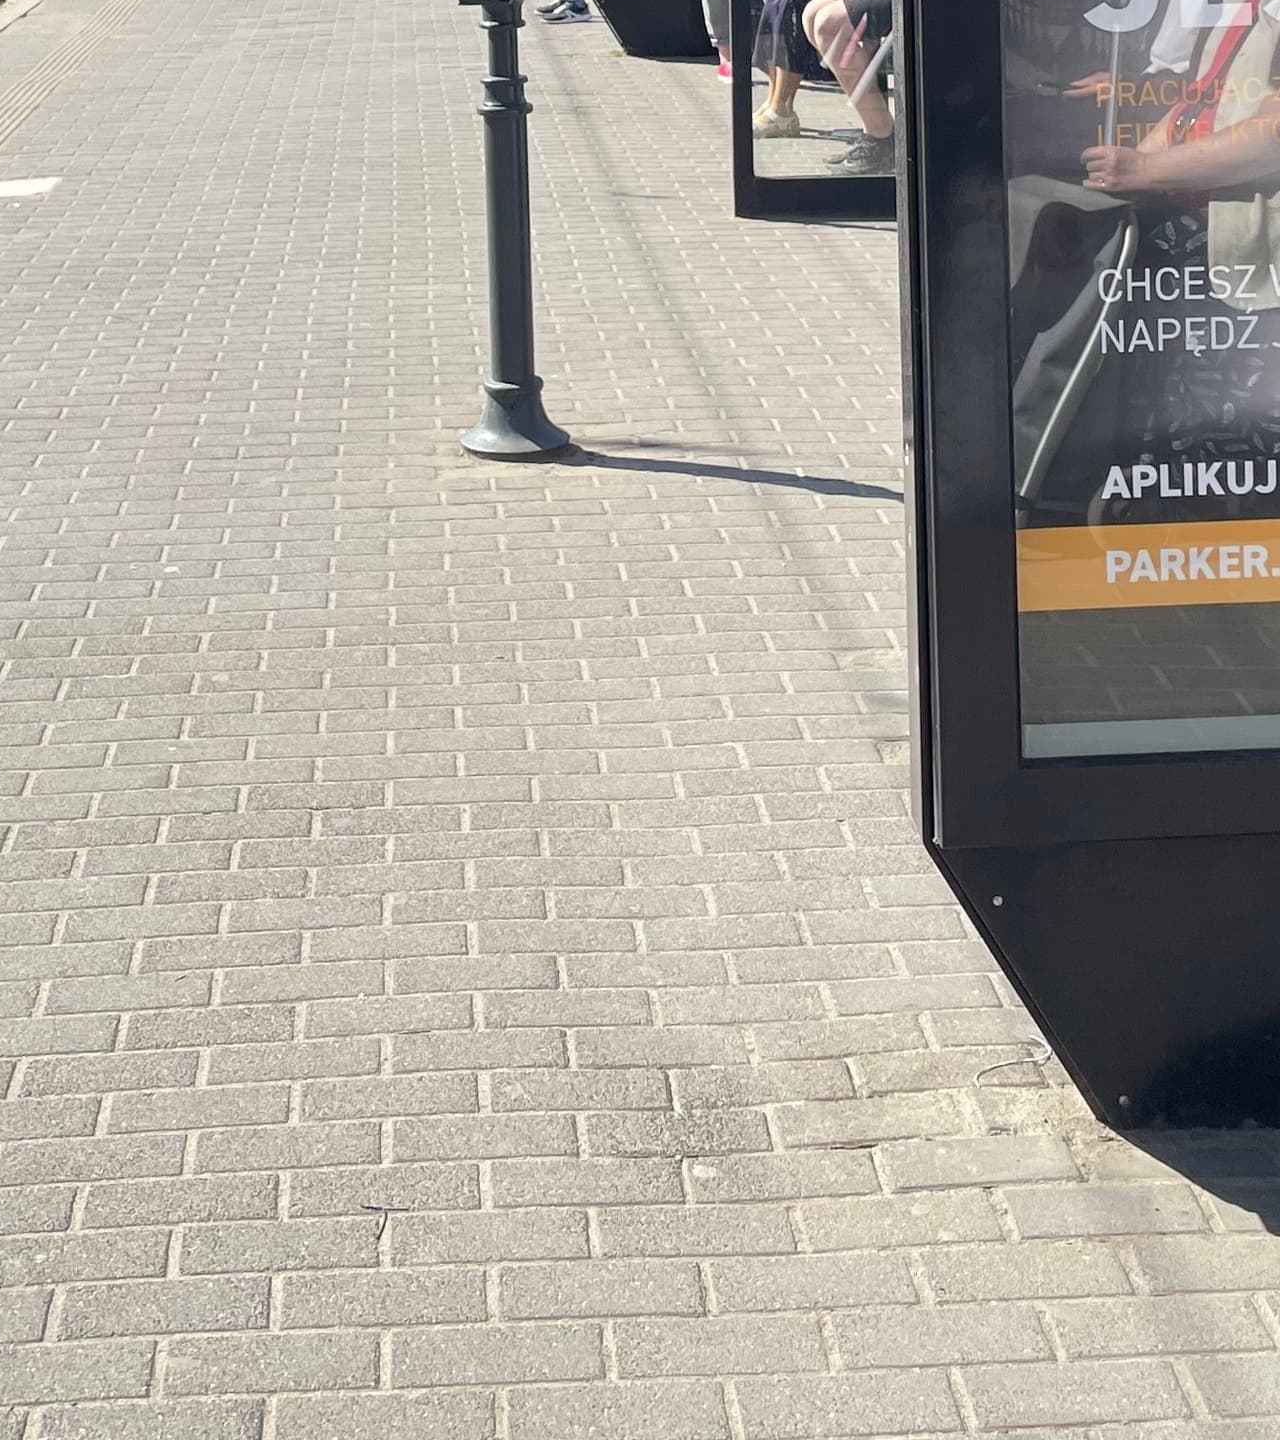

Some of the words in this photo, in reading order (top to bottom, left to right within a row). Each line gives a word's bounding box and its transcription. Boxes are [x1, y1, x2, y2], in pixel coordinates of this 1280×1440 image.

[1097, 264, 1258, 304] CHCESZ
[1100, 307, 1260, 357] NAPĘDŹ
[1101, 458, 1277, 500] APLIKUJ
